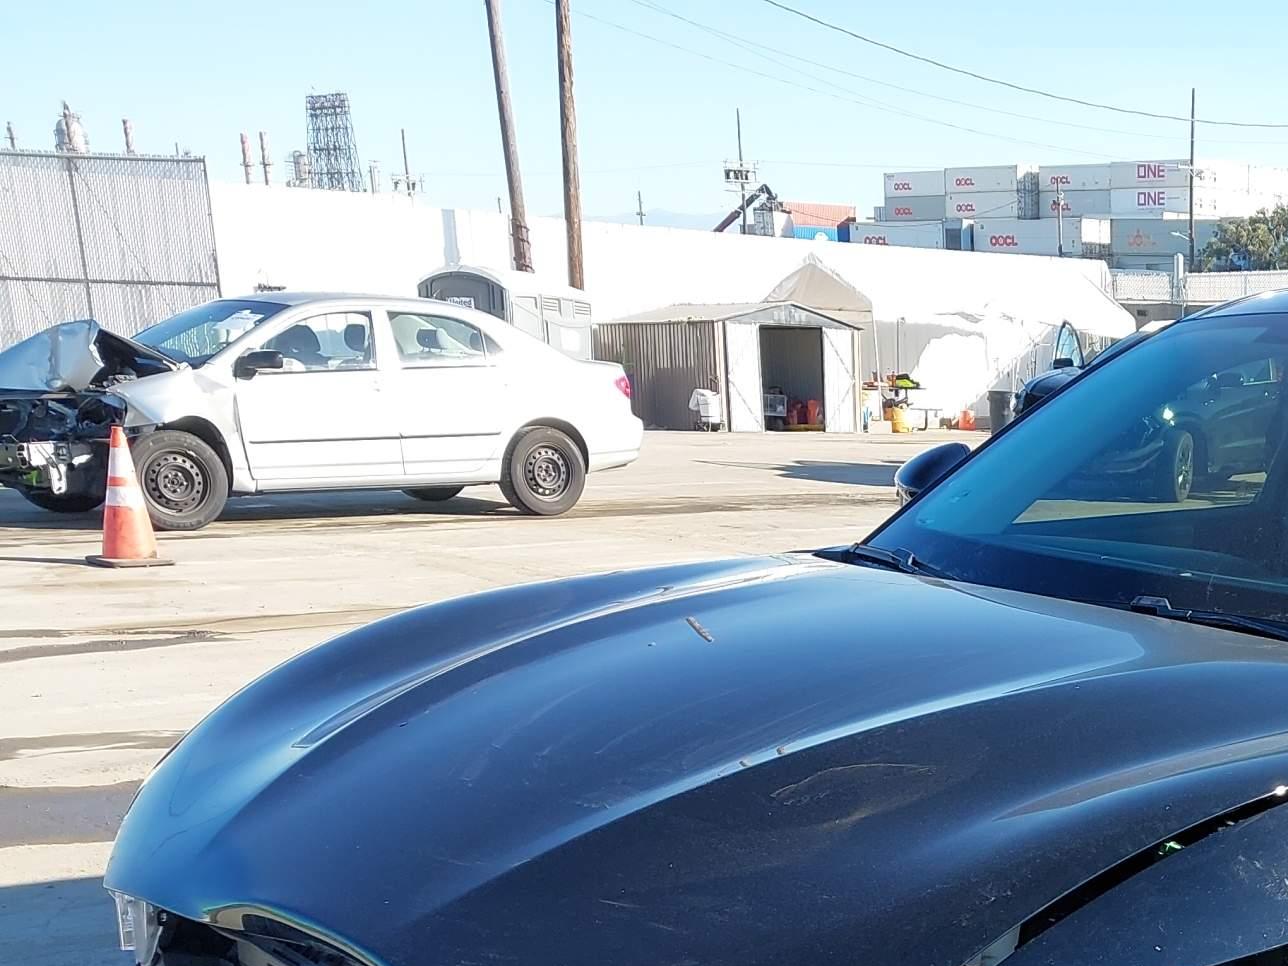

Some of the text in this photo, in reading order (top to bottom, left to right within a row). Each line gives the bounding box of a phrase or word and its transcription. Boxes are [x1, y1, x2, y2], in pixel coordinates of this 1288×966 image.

[1137, 164, 1166, 179] ONE
[893, 182, 912, 191] OOCL
[955, 177, 975, 187] OOCL
[1137, 192, 1166, 206] ONE
[894, 207, 912, 216] OOCL
[955, 203, 975, 213] OOCL
[1050, 202, 1071, 211] OCL
[990, 235, 1018, 247] OOCL
